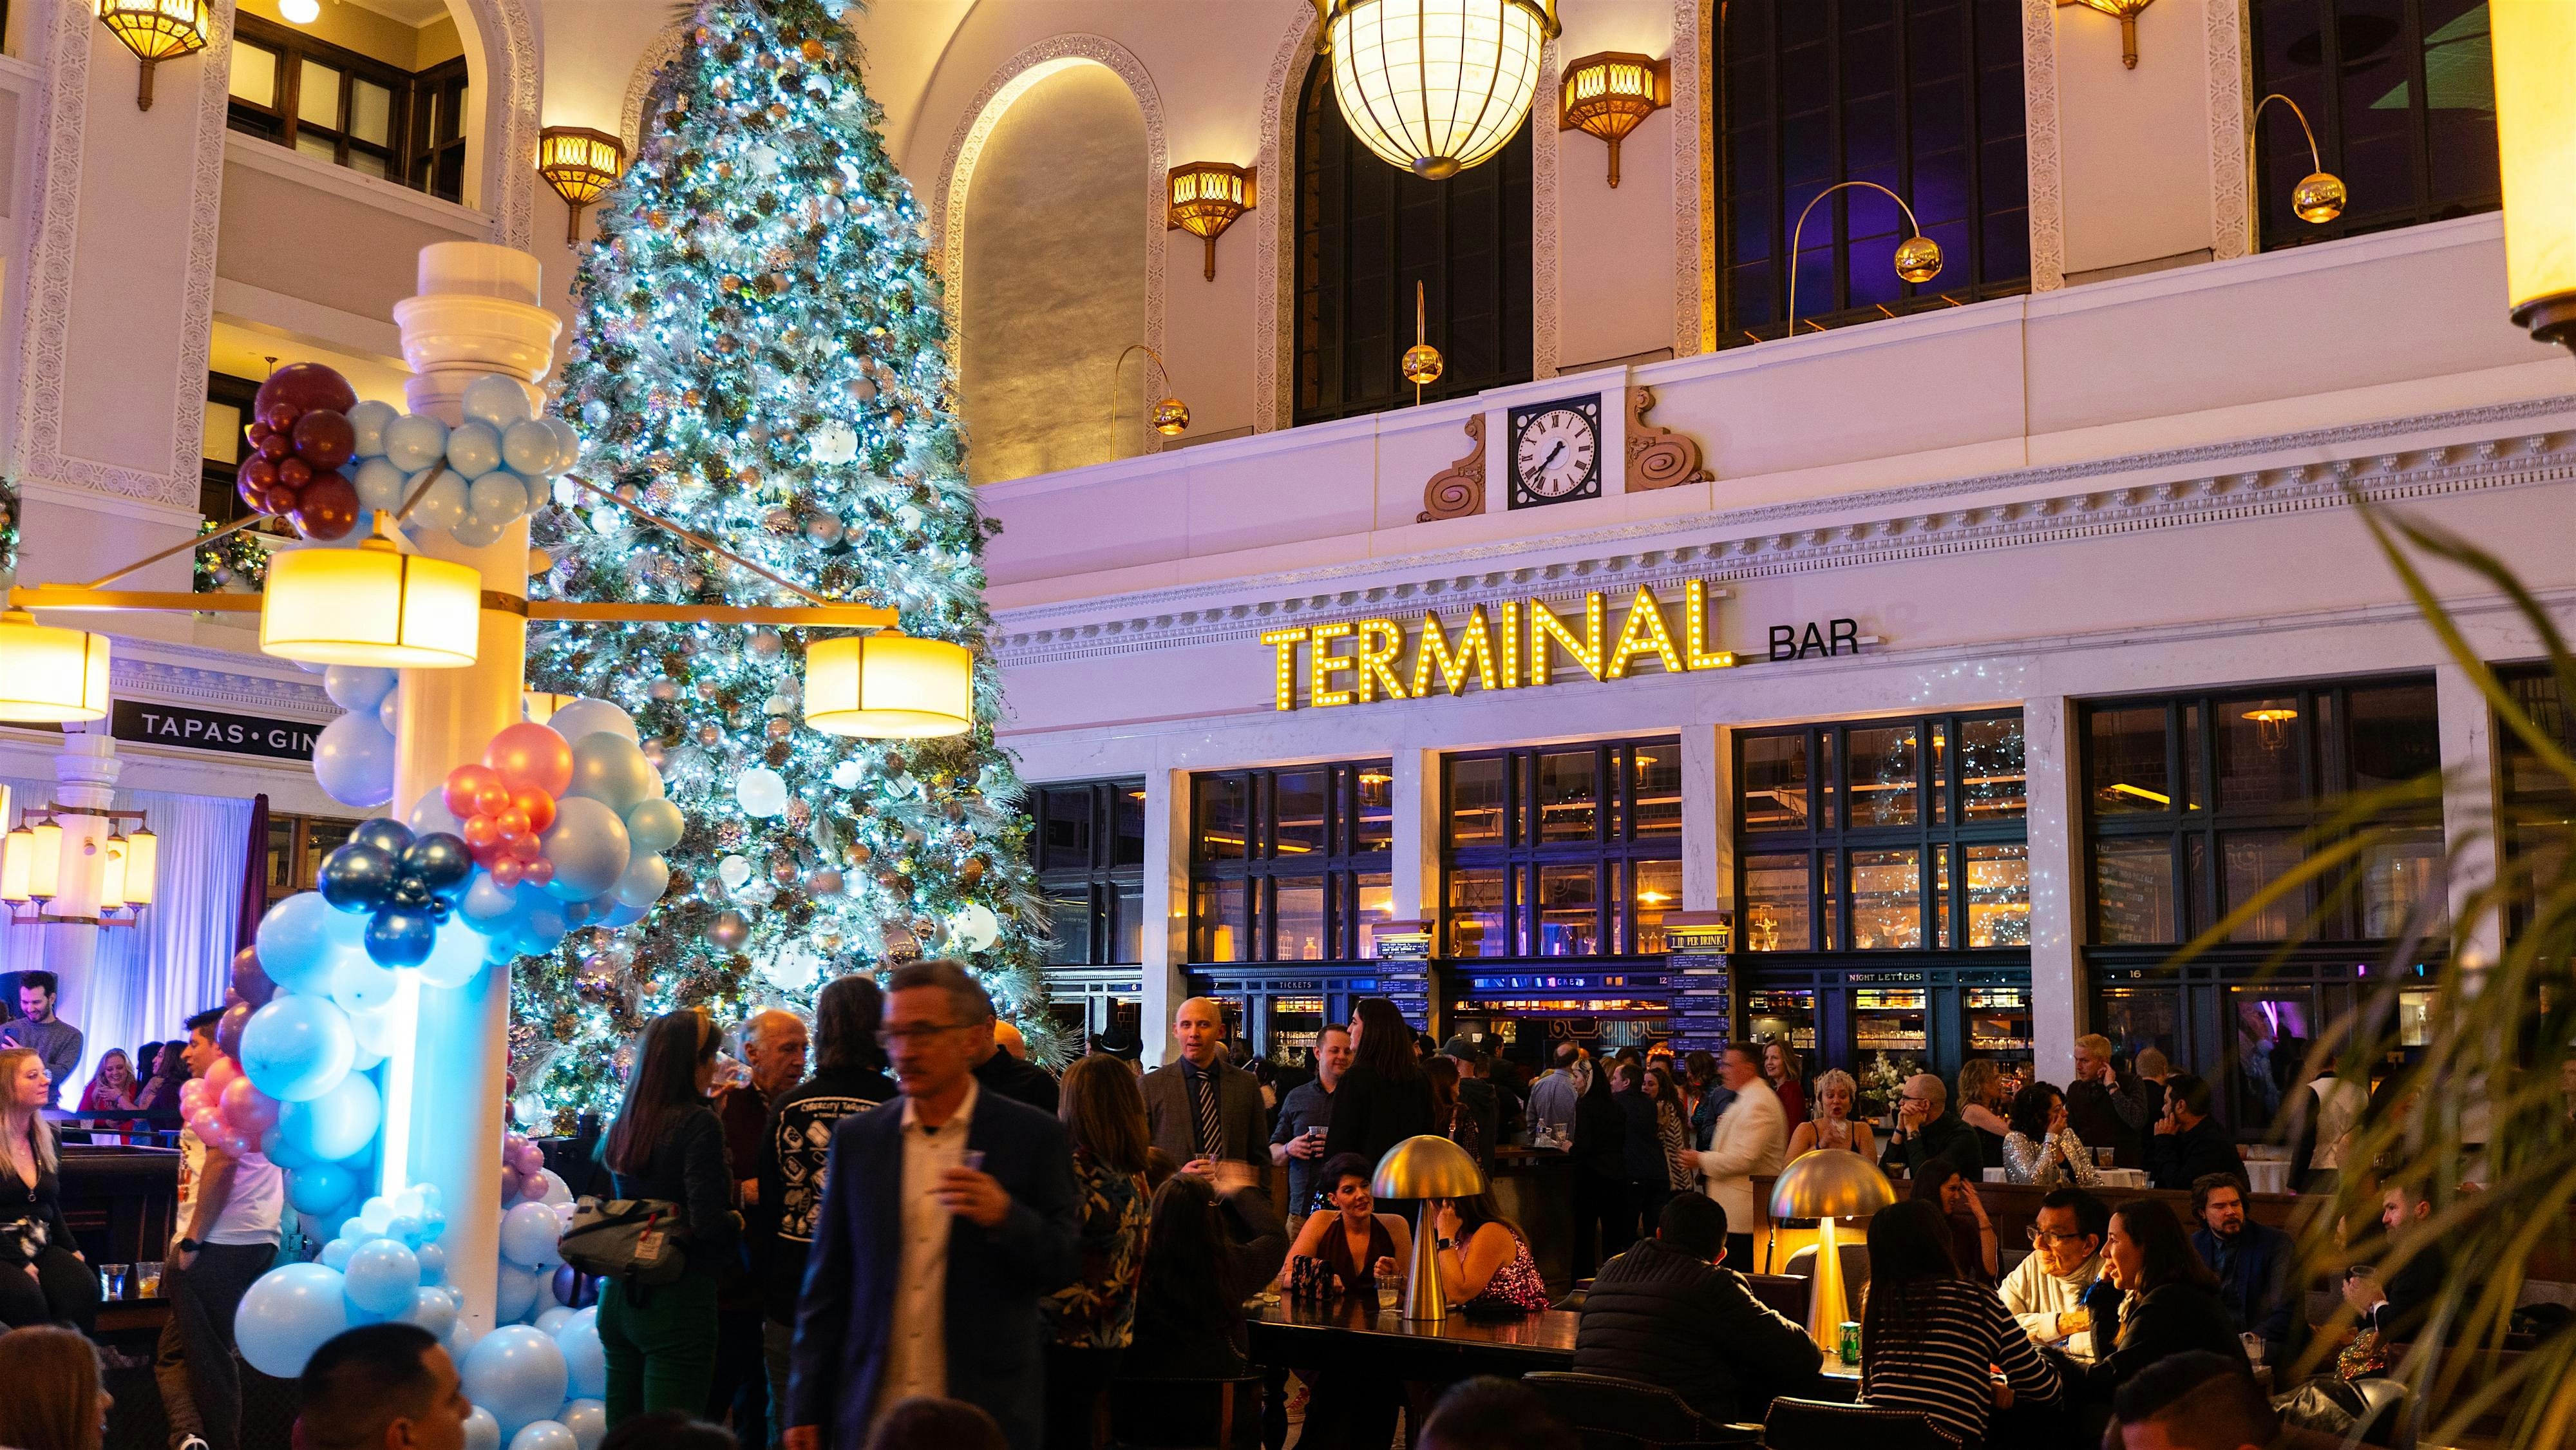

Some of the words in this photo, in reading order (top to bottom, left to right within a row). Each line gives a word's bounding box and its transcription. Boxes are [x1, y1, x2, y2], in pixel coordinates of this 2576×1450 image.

[1260, 579, 1739, 712] TERMINAL
[1768, 618, 1859, 662] BAR
[141, 712, 245, 744] TAPAS
[267, 729, 321, 752] GIN
[1678, 937, 1685, 946] ID
[1687, 936, 1699, 946] PER
[1700, 934, 1725, 946] DRINK!
[1878, 973, 1922, 981] LETTERS
[2130, 969, 2142, 978] 16
